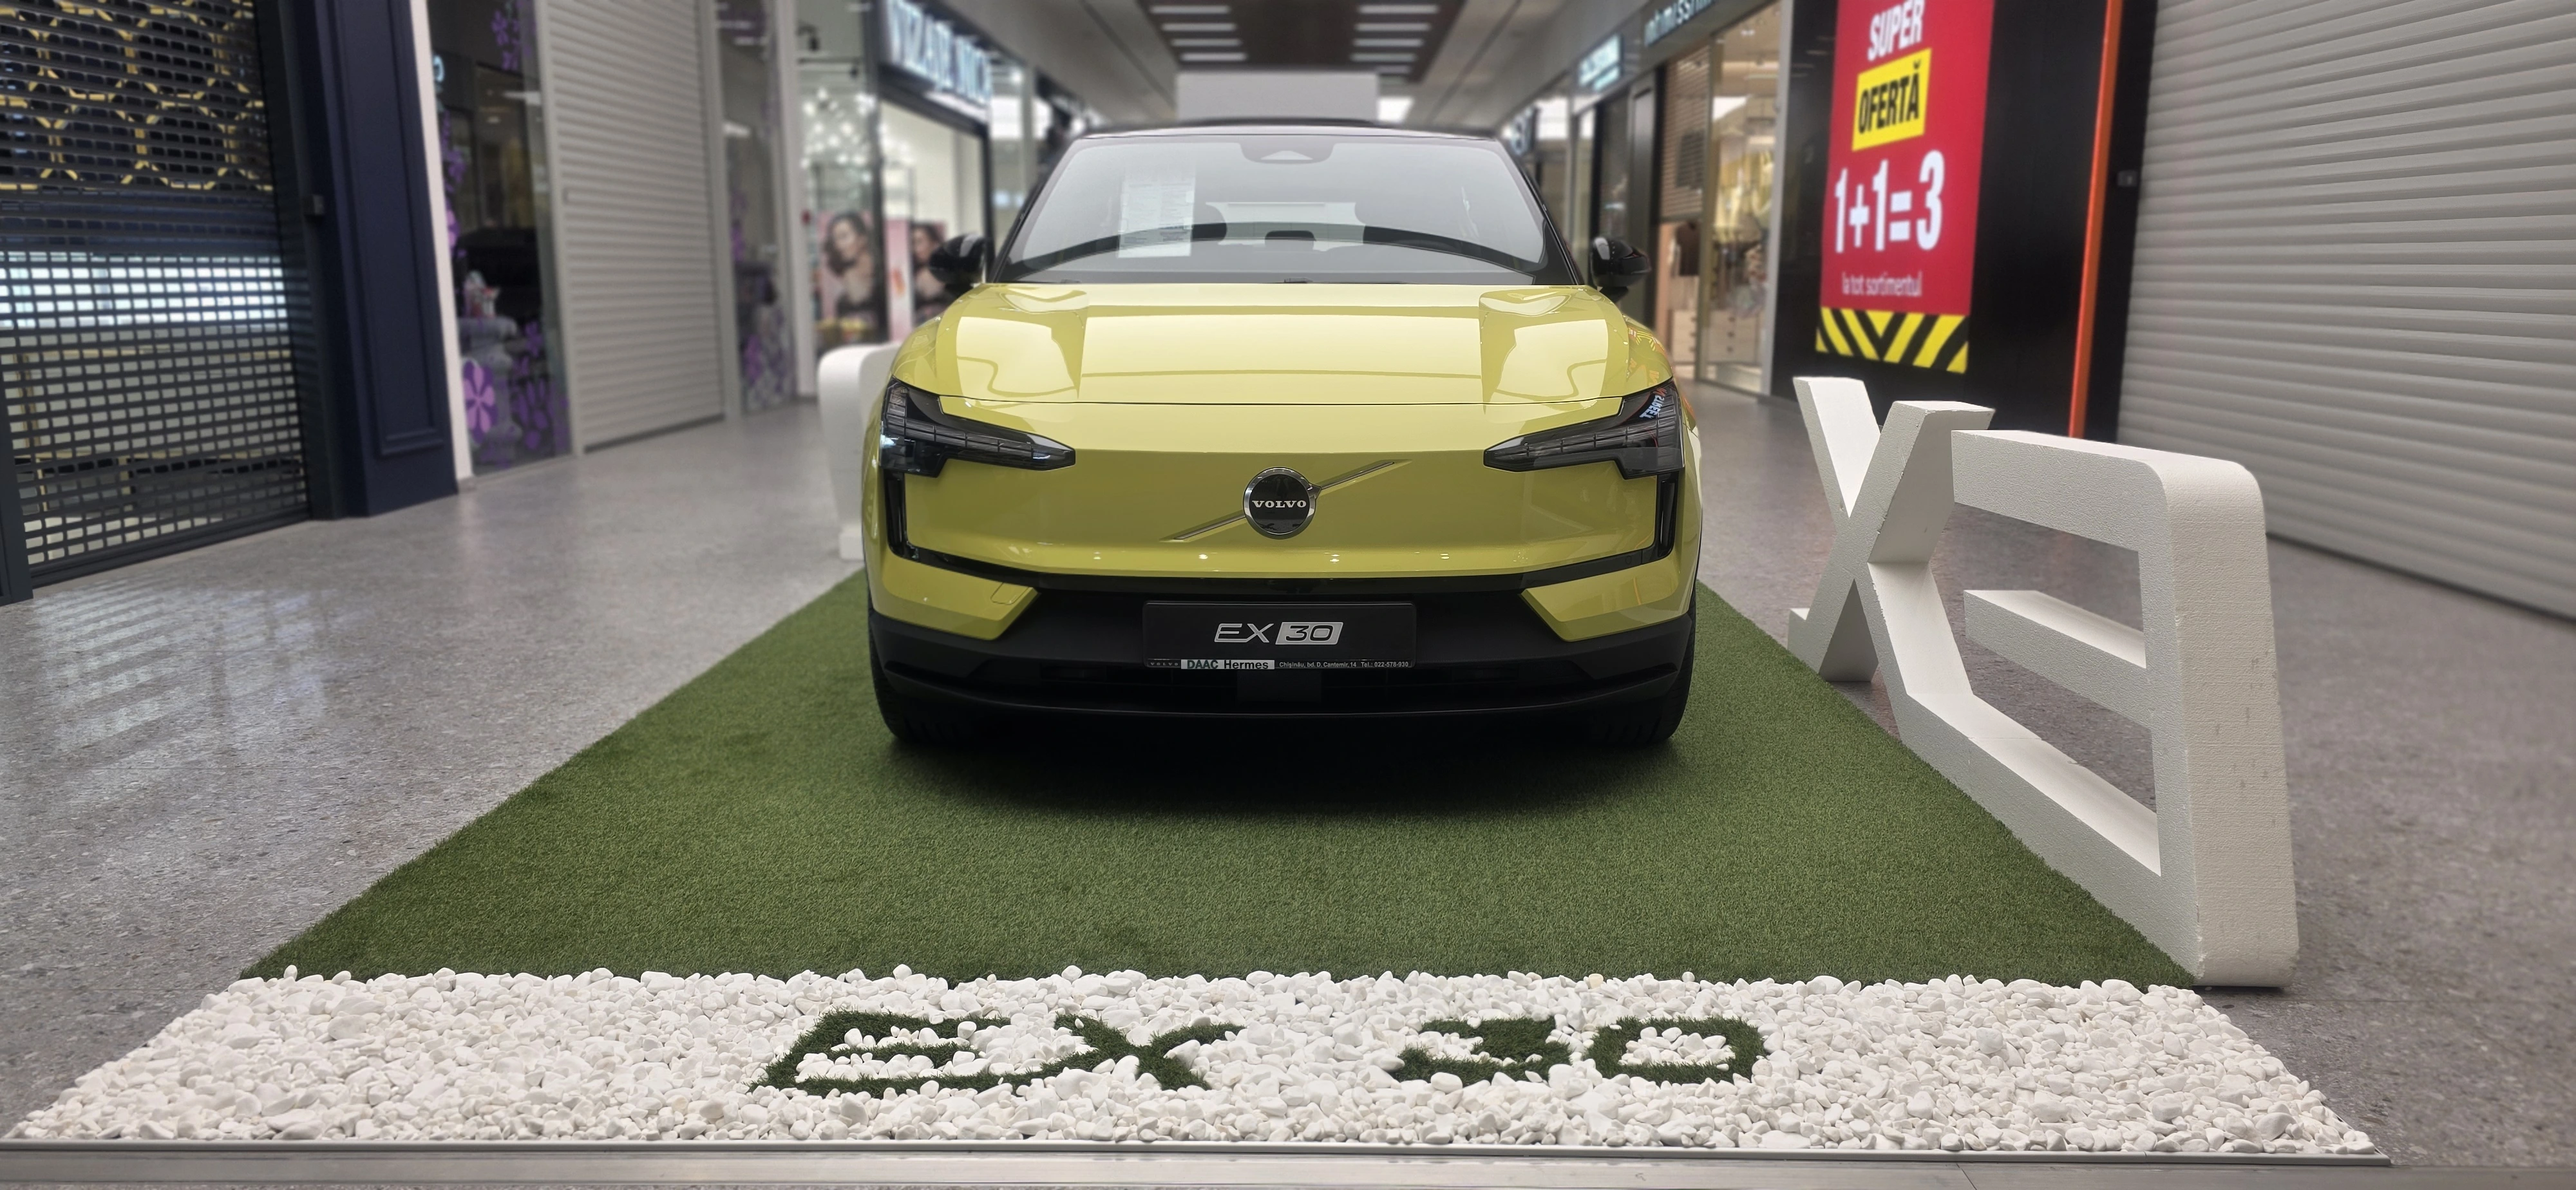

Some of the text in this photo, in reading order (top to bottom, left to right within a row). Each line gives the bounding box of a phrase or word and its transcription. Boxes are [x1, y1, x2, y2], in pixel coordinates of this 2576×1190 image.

[1868, 0, 1926, 61] SUPER
[1859, 59, 1920, 134] OFERTĂ
[1834, 150, 1945, 253] 1+1=3
[1252, 500, 1307, 508] VOLVO
[1215, 623, 1334, 643] EX 30
[1187, 659, 1218, 669] DAAC
[1224, 659, 1269, 669] Hermes
[750, 1008, 1246, 1098] EX
